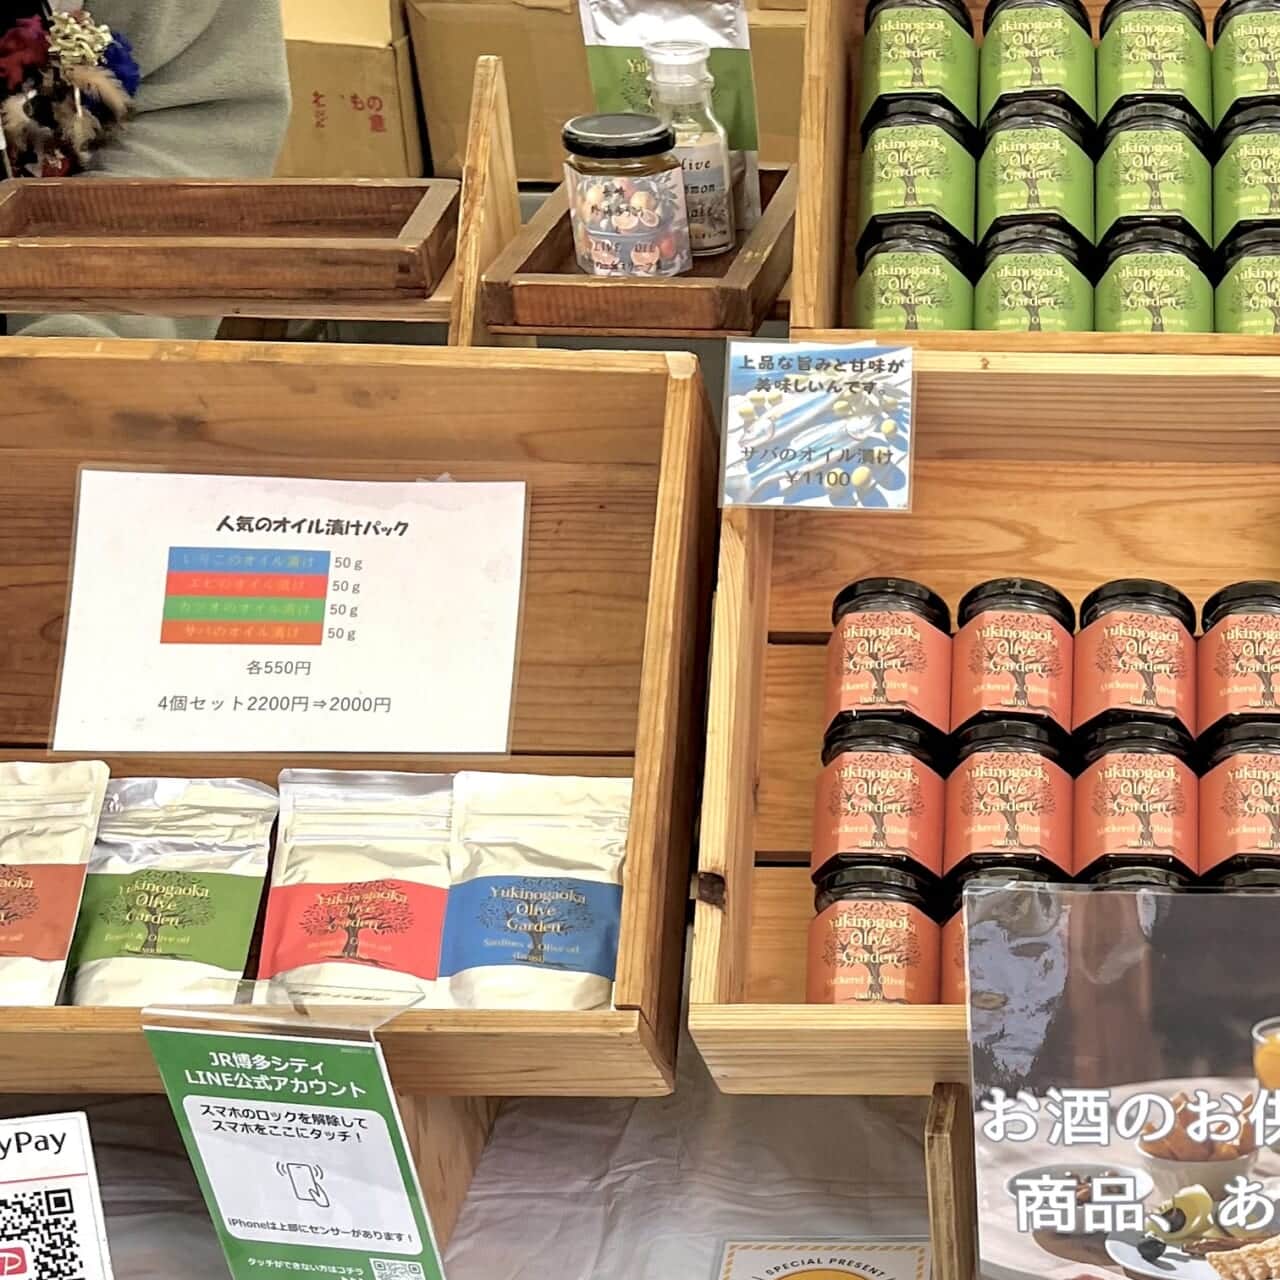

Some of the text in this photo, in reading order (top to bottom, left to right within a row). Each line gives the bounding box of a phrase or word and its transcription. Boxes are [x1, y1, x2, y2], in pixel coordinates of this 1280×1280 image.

[681, 157, 712, 171] live
[739, 354, 905, 374] 上品な旨みと甘味が
[755, 376, 886, 395] 美味しいんです。
[215, 514, 409, 537] 人気のオイル漬けパック
[857, 640, 895, 655] Olive
[997, 641, 1035, 656] Olive
[1126, 641, 1165, 656] Olive
[1242, 642, 1280, 657] Olive
[246, 659, 312, 677] 各550円
[849, 655, 903, 672] Garden
[989, 656, 1044, 674] Garden
[1118, 657, 1174, 676] Garden
[854, 781, 896, 798] Olive
[986, 780, 1028, 797] Olive
[1120, 780, 1161, 797] Olive
[847, 798, 902, 815] Garden
[979, 797, 1035, 814] Garden
[1113, 797, 1168, 814] Garden
[136, 892, 178, 911] Olive
[490, 885, 586, 905] Yukinogaoka
[516, 903, 557, 916] Olive
[126, 910, 180, 927] Garden
[506, 917, 562, 933] Garden
[850, 930, 892, 947] Olive
[842, 948, 899, 965] Garden
[207, 1050, 326, 1077] JR博多シティ
[184, 1068, 368, 1099] LINE公式アカウント
[199, 1103, 369, 1130] スマホのロックを解除して
[211, 1119, 363, 1144] スマホをここにタッチ！
[765, 1257, 888, 1278] SPECIAL PRESENT
